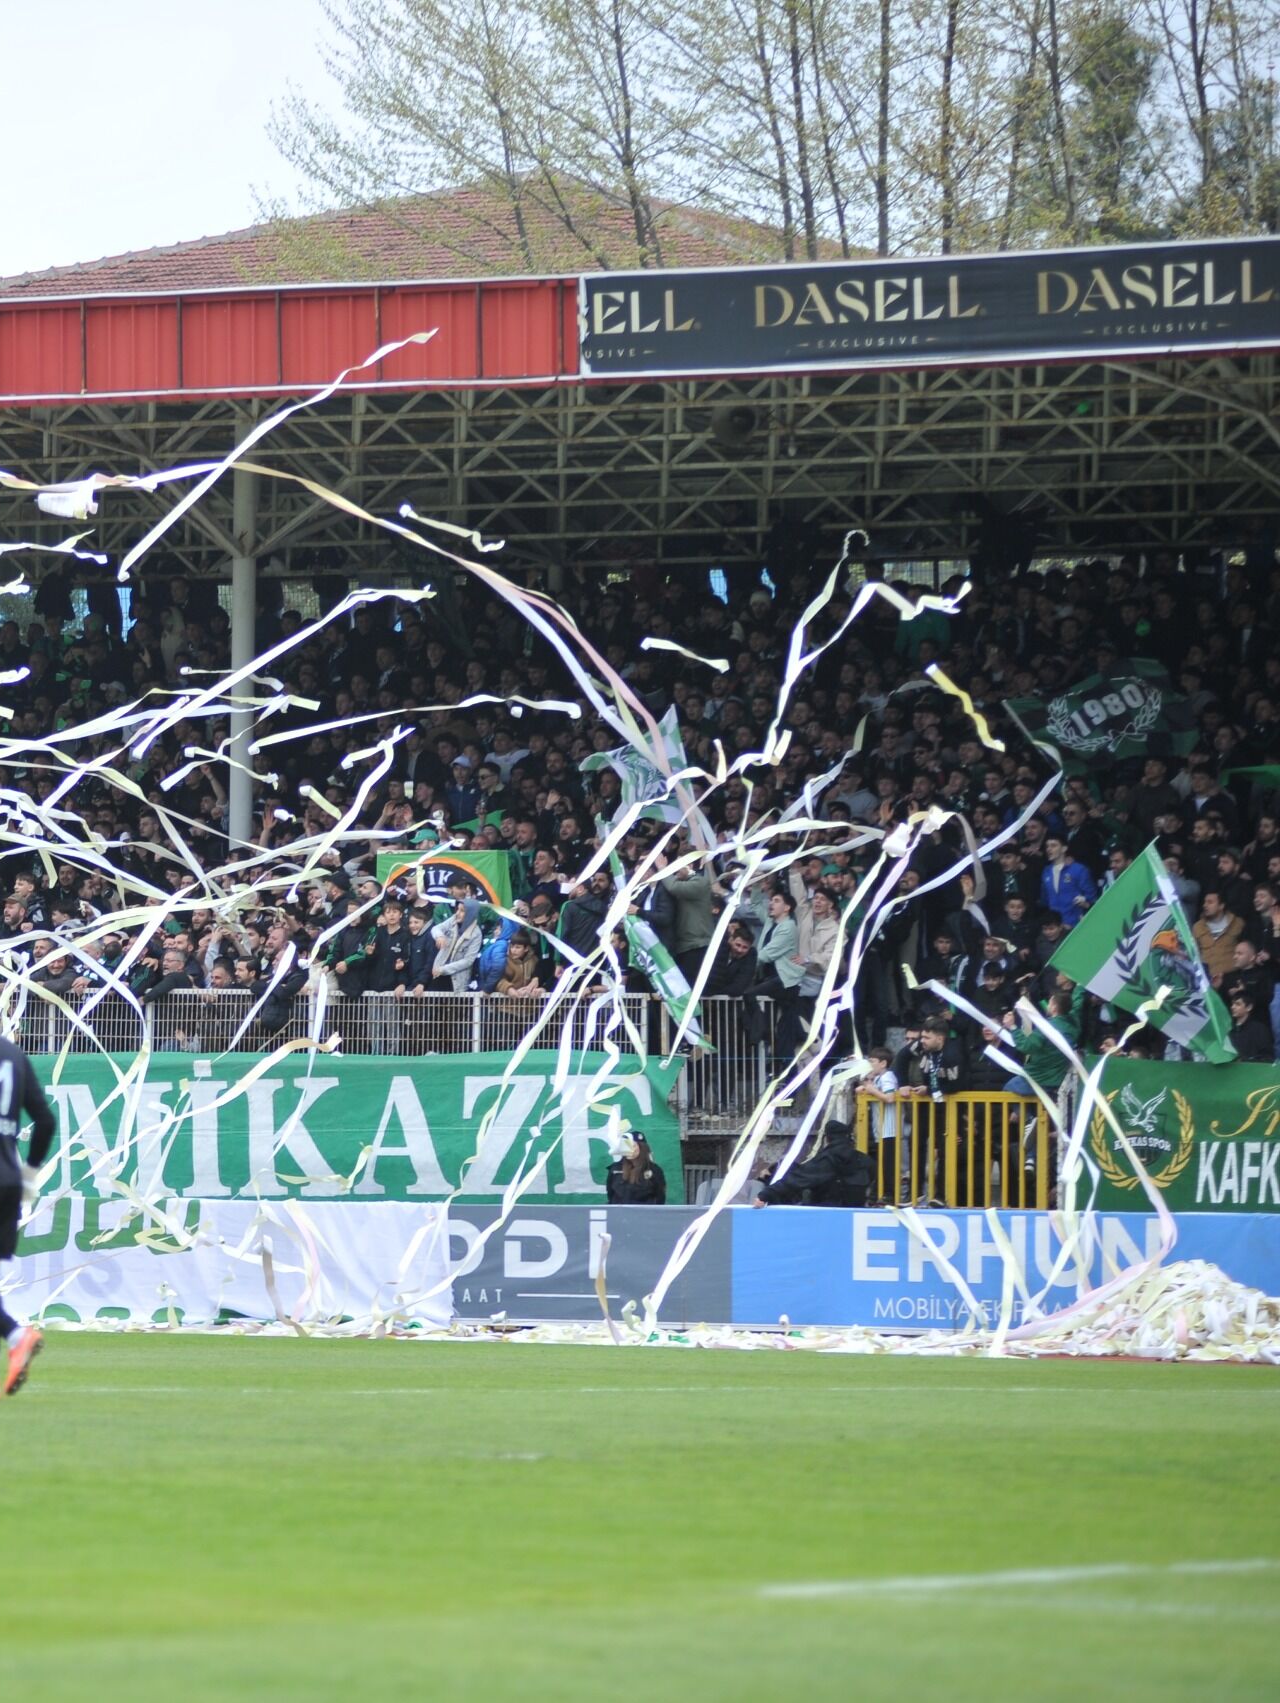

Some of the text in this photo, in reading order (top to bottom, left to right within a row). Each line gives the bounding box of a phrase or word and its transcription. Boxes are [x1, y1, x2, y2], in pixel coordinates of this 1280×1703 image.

[755, 275, 980, 327] DASELL
[1038, 260, 1274, 315] DASELL
[817, 335, 919, 349] EXCLUSIVE
[1103, 321, 1209, 335] EXCLUSIVE
[1070, 683, 1146, 738] 1980
[852, 1211, 1161, 1288] ERHUN
[873, 1294, 972, 1320] MOBİLYA
